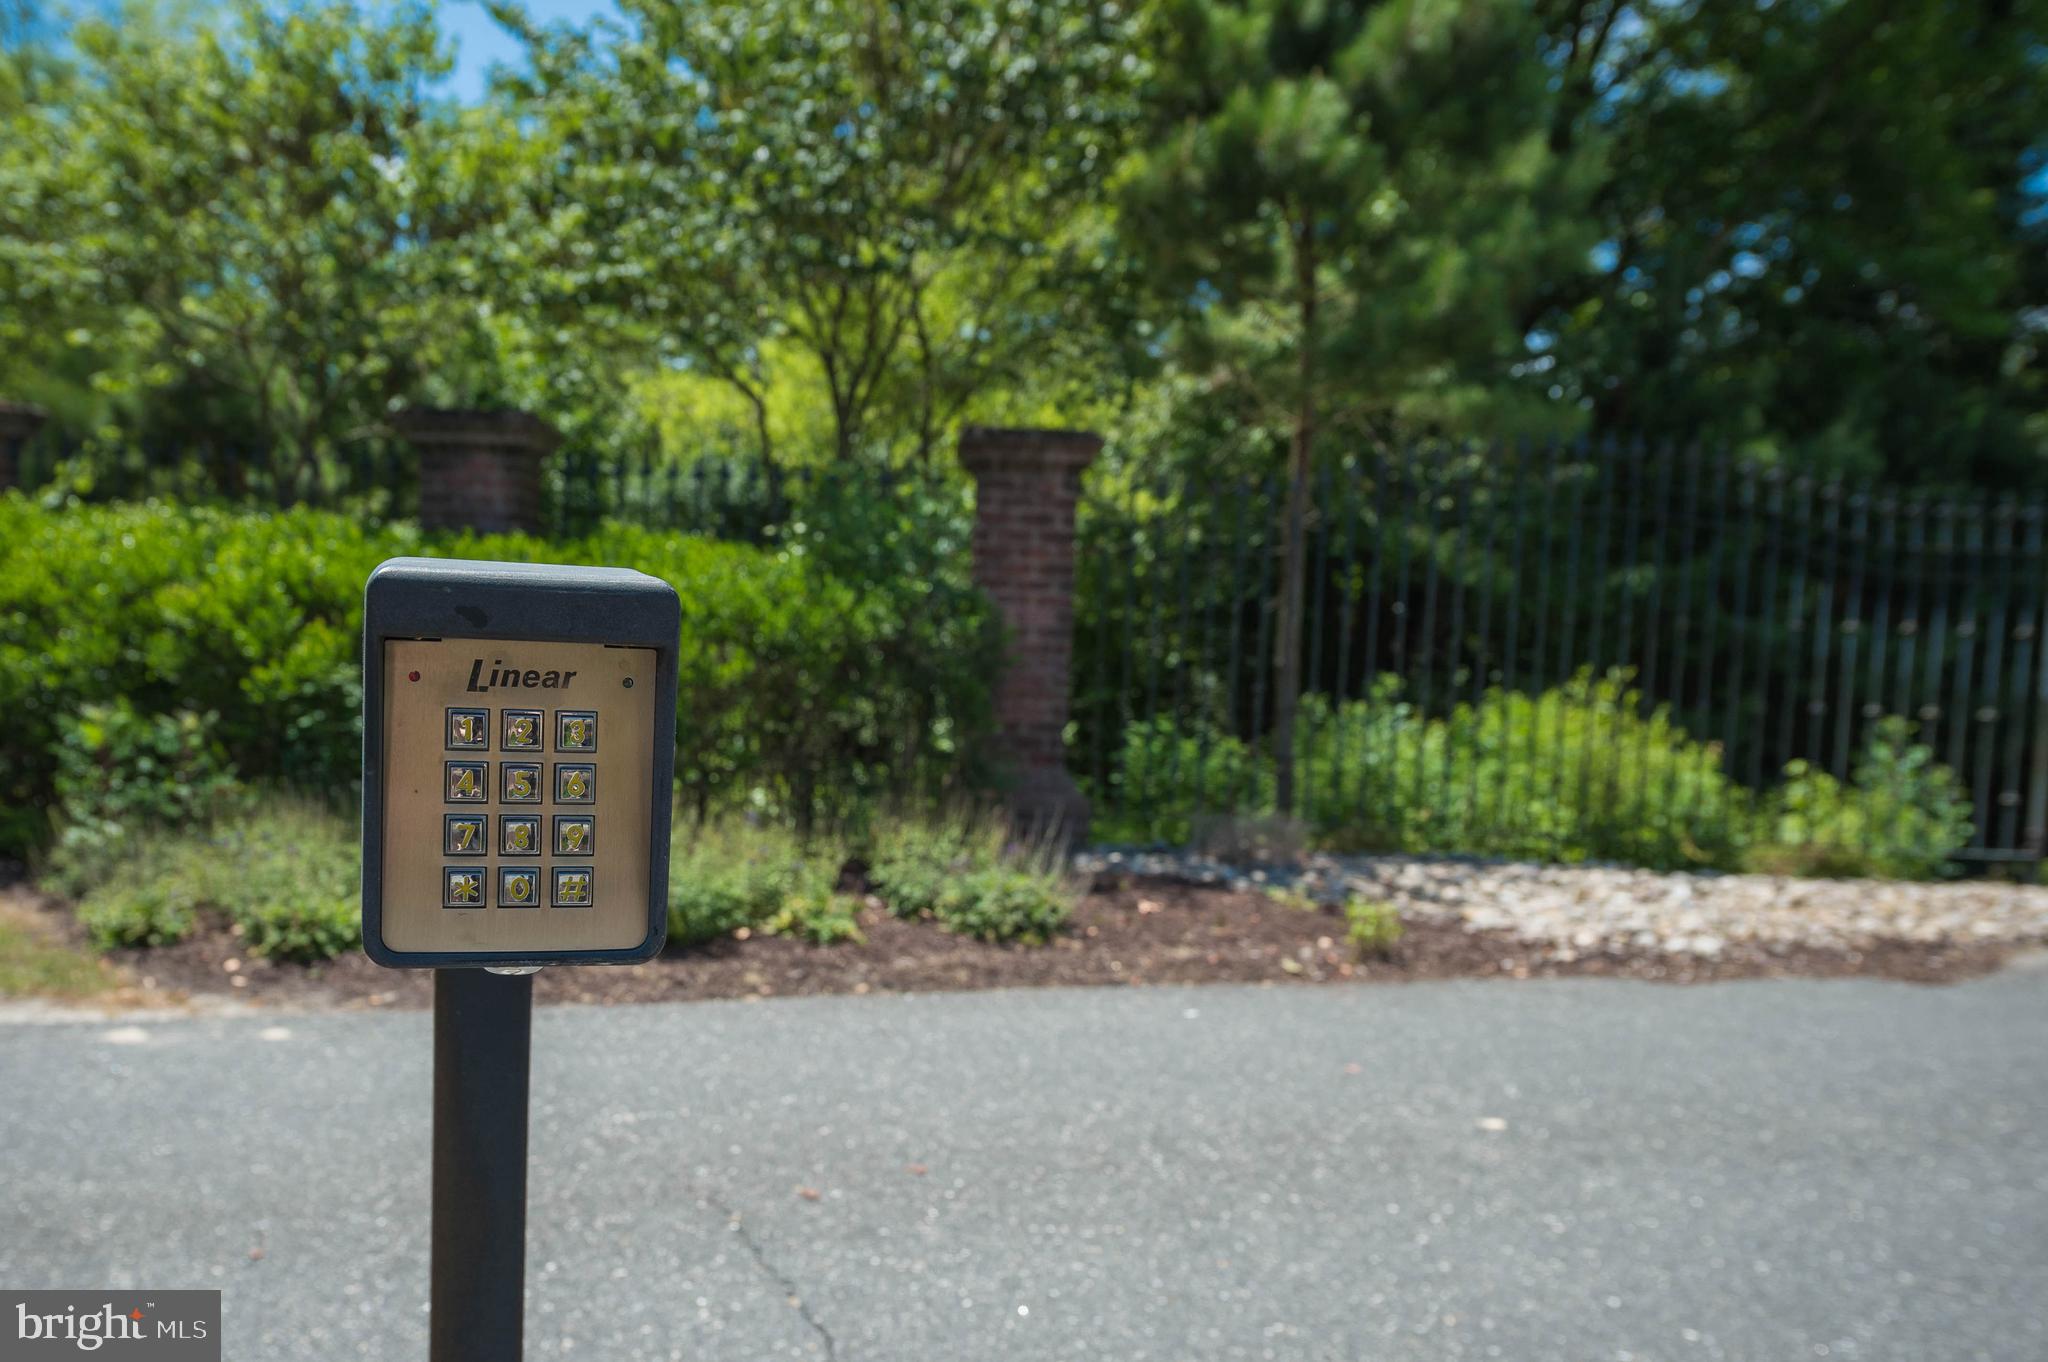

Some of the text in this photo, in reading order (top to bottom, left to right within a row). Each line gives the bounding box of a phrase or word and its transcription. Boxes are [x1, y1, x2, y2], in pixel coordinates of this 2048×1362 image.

[466, 658, 577, 692] Linear
[461, 718, 586, 745] 1 2 3
[456, 770, 585, 797] 4 5 6
[457, 823, 584, 850] 7 8 9
[510, 877, 530, 901] 0
[559, 876, 586, 901] #
